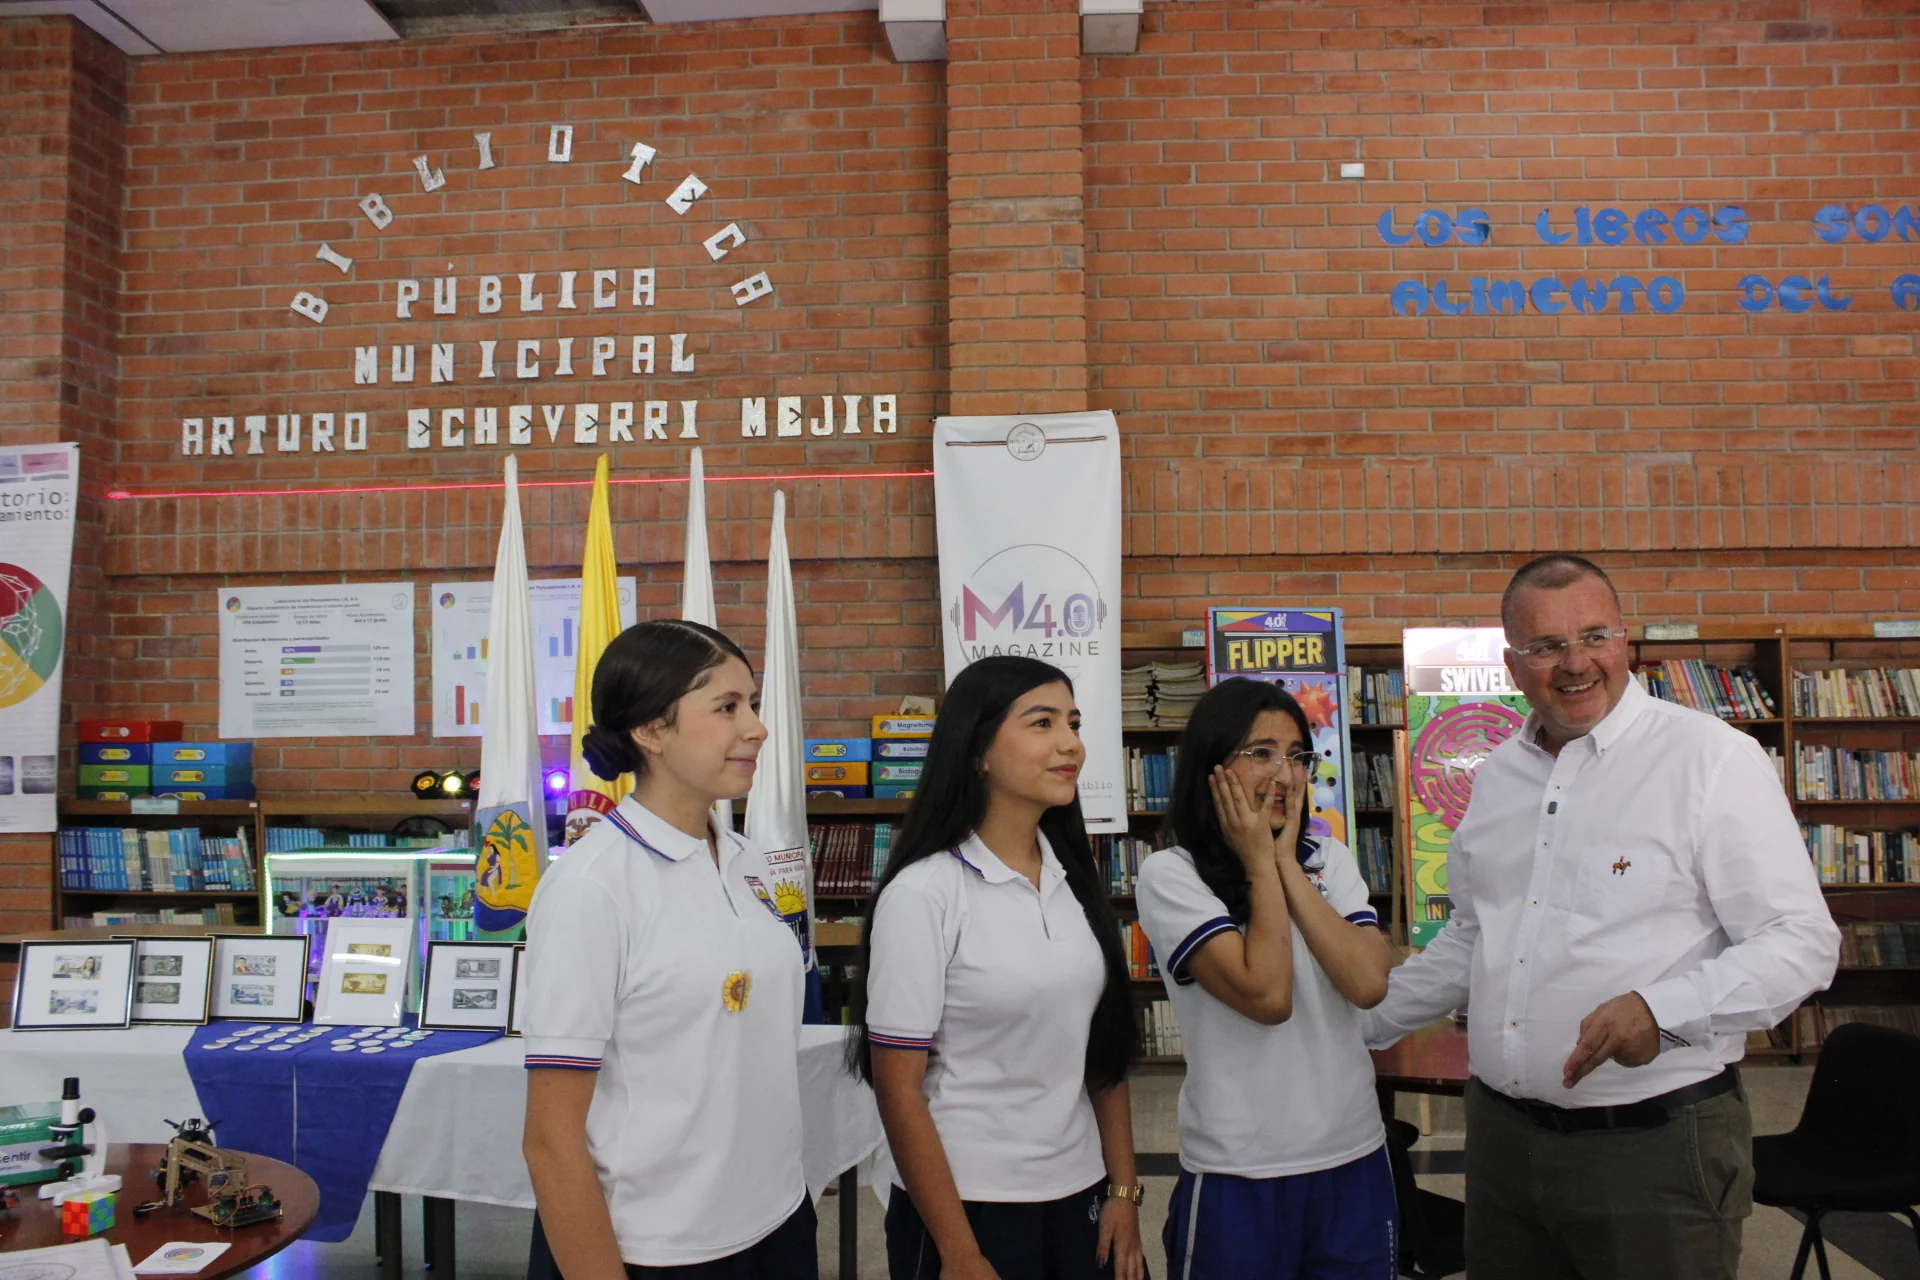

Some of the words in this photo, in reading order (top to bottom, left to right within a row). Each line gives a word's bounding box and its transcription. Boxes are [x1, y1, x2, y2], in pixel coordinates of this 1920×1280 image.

[291, 125, 773, 324] BIBLIOTECA
[1376, 208, 1490, 246] LOS
[1535, 206, 1750, 245] LIBROS
[1812, 204, 1920, 244] SON
[397, 262, 655, 318] PÚBLICA
[1391, 275, 1684, 317] ALIMENTO
[1737, 274, 1853, 313] DEL
[355, 334, 694, 384] MUNICIPAL
[182, 412, 367, 456] ARTURO
[407, 400, 698, 449] ECHEVERRI
[741, 395, 897, 437] MEJIA
[971, 641, 1100, 660] MAGAZINE
[1228, 636, 1325, 671] FLIPPER
[1441, 668, 1511, 692] SWIVEL
